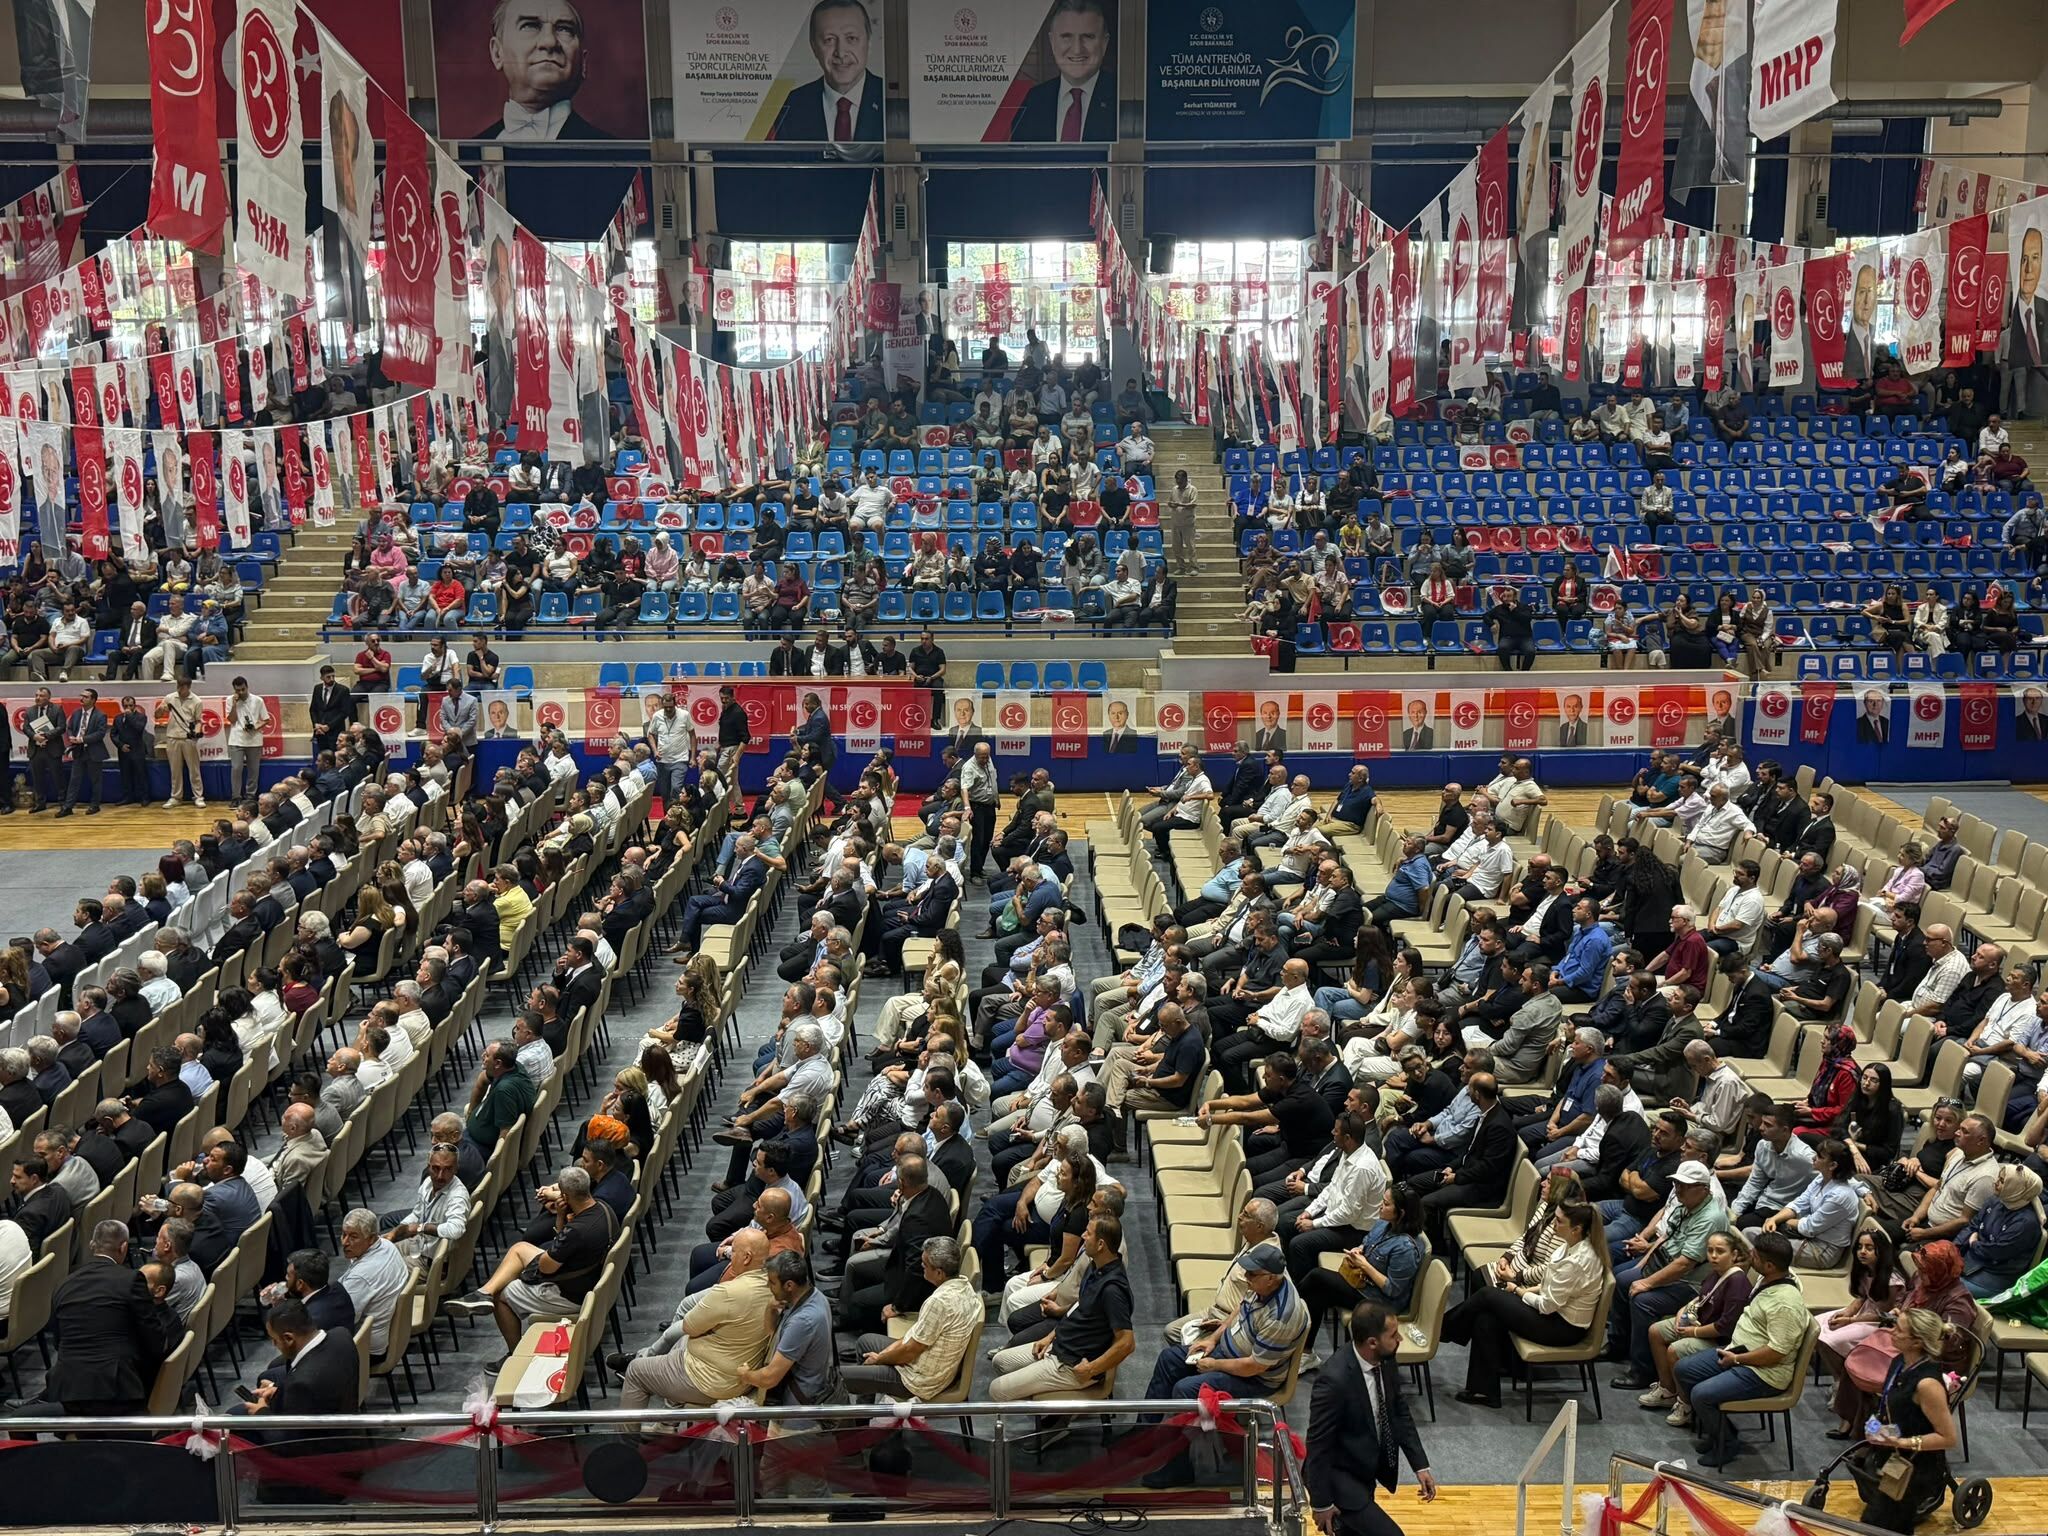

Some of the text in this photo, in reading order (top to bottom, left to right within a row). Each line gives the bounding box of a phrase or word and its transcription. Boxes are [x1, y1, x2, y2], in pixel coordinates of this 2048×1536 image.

[687, 52, 770, 62] TÜM ANTRENÖR VE
[925, 54, 1008, 64] TÜM ANTRENÖR VE
[1172, 53, 1251, 64] TÜM ANTRENÖR
[690, 62, 767, 71] SPORCULARIMIZA
[928, 64, 1004, 72] SPORCULARIMIZA
[1159, 65, 1262, 75] VE SPORCULARIMIZA
[686, 72, 772, 81] BAŞARILAR DİLİYORUM
[967, 74, 1009, 82] DİLİYORUM
[1760, 36, 1823, 110] MHP
[1162, 78, 1260, 89] BAŞARILAR DİLİYORUM
[1618, 176, 1652, 233] MHP
[1567, 235, 1590, 277] MHP
[718, 320, 736, 328] MHP
[1982, 329, 1998, 342] MHP
[1906, 342, 1932, 364] MHP
[1775, 360, 1799, 377] MHP
[1821, 361, 1844, 378] MHP
[1396, 376, 1410, 404] MHP
[1758, 728, 1785, 738] MHP
[1914, 732, 1940, 742] MHP
[749, 736, 764, 745] HP
[850, 739, 876, 748] MHP
[1508, 738, 1532, 748] MHP
[1610, 735, 1634, 745] MHP
[1656, 736, 1679, 746] MHP
[1964, 734, 1990, 744] MHP
[386, 744, 401, 753] HP
[900, 740, 924, 749] MHP
[1000, 740, 1026, 750] MHP
[1056, 742, 1081, 752] MHP
[1160, 741, 1182, 750] MHP
[1210, 742, 1232, 750] MHP
[1308, 742, 1333, 751] MHP
[1358, 742, 1383, 751] MHP
[1454, 740, 1478, 749] MHP
[262, 747, 277, 755] HP
